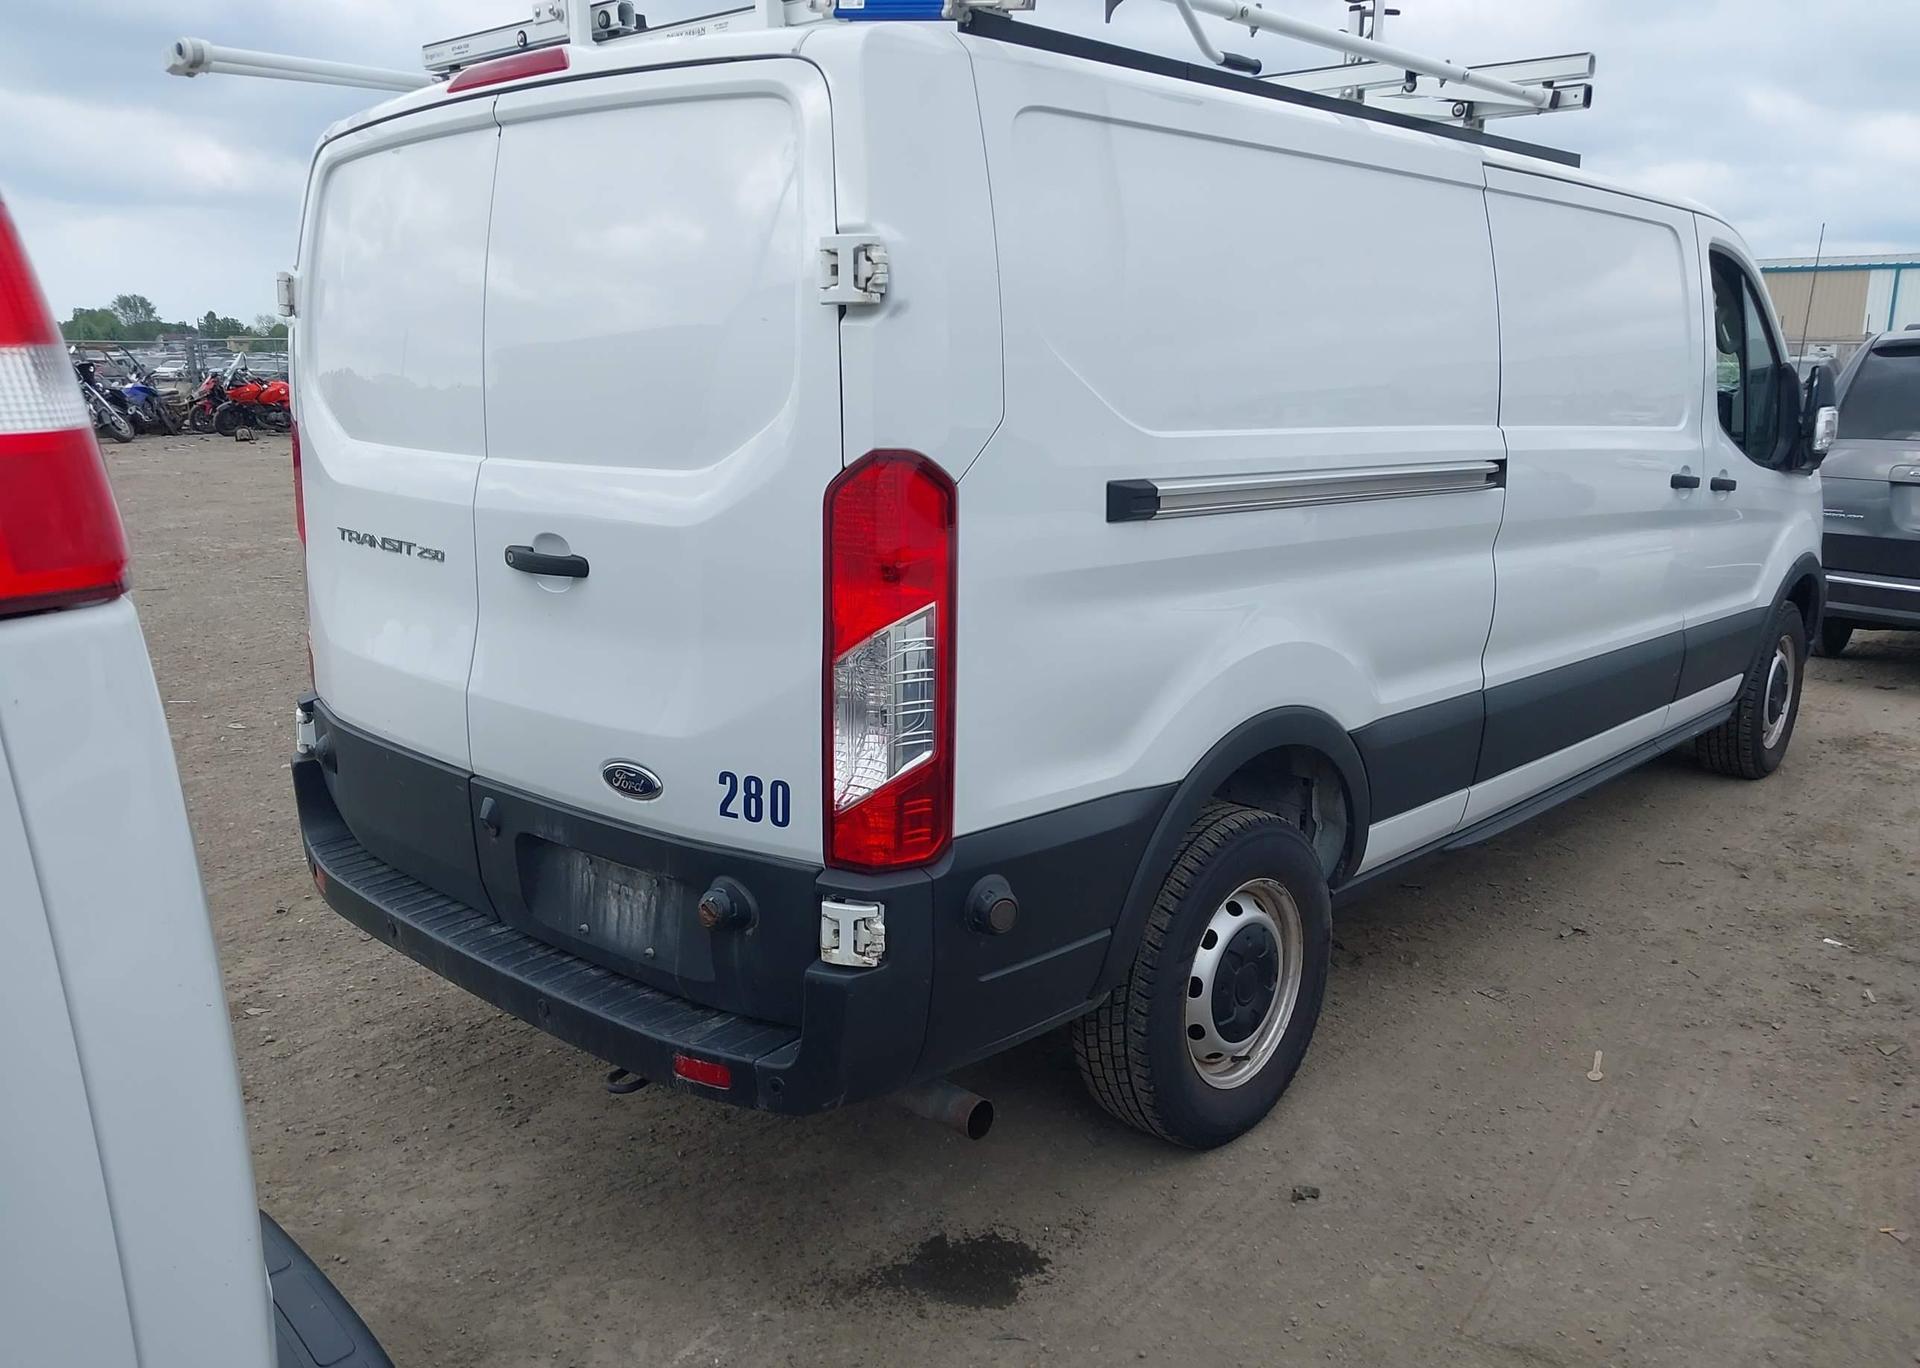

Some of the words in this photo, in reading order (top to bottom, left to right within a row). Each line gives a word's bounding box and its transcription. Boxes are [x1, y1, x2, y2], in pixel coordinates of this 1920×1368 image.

[337, 526, 416, 556] TRANSIT
[417, 546, 445, 562] 250
[612, 769, 646, 793] Ford
[718, 771, 790, 828] 280
